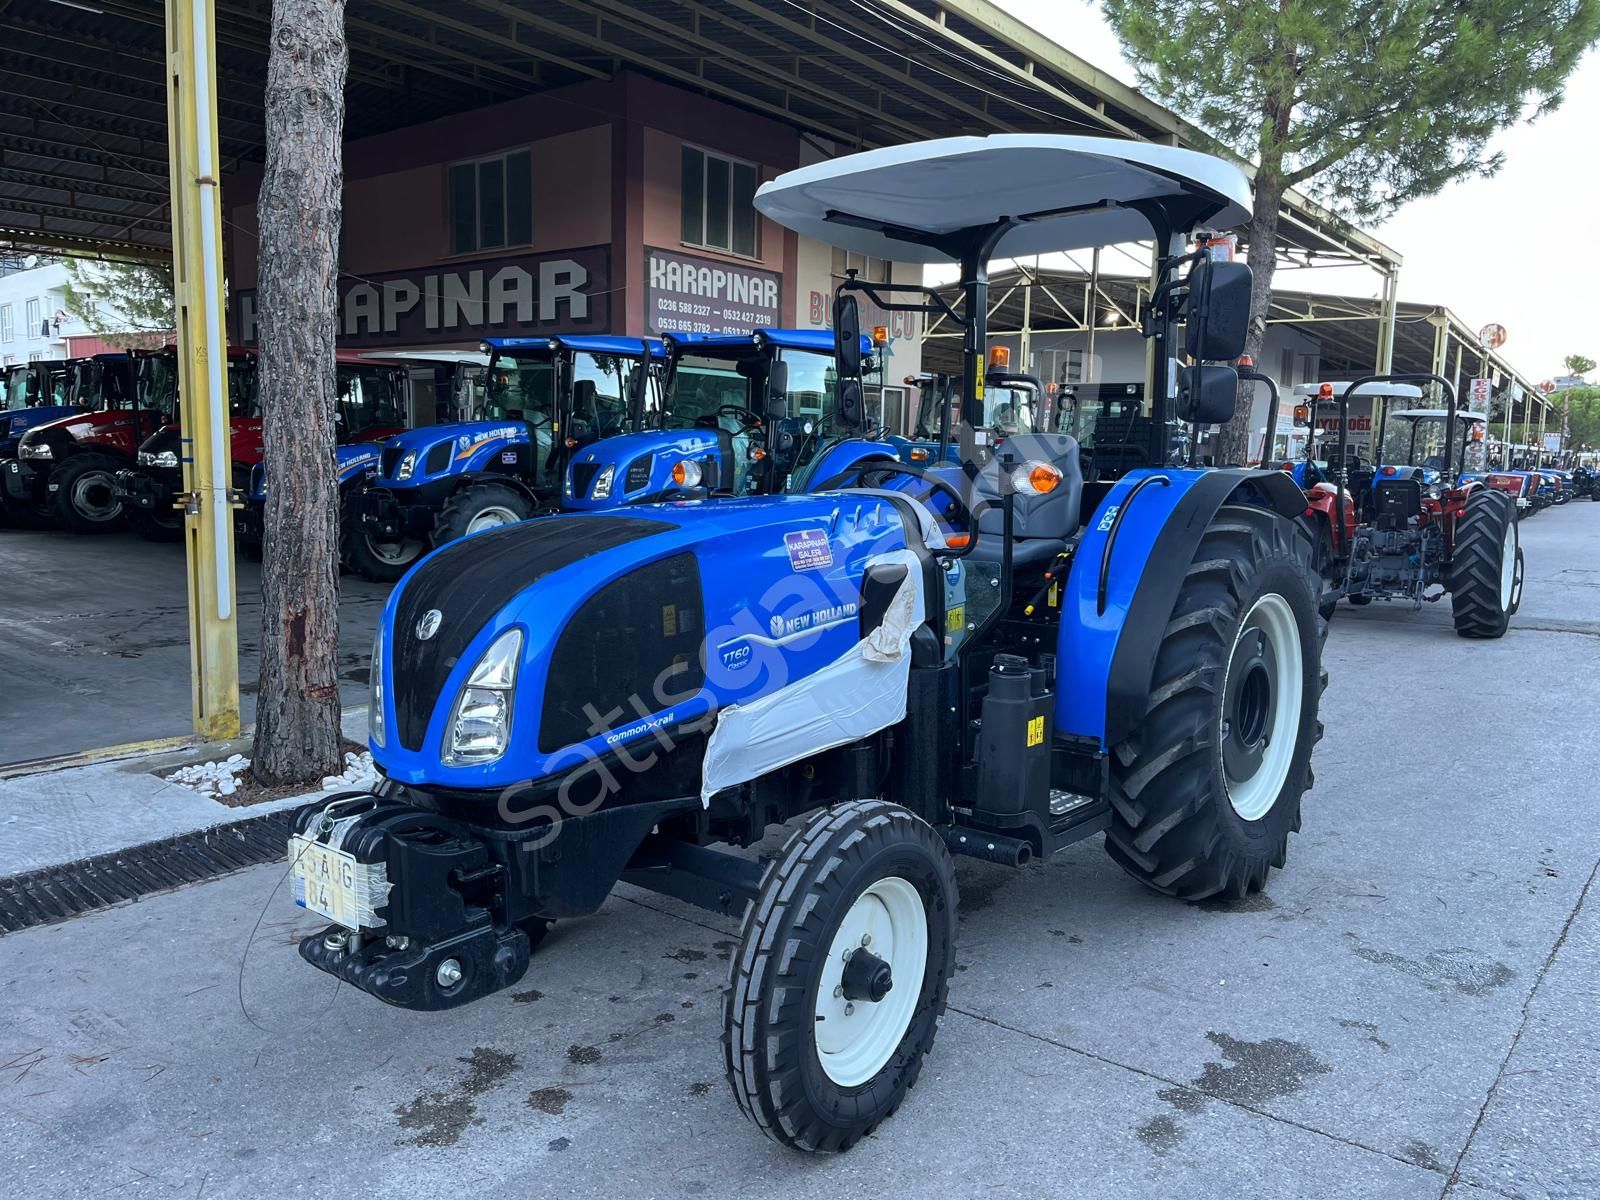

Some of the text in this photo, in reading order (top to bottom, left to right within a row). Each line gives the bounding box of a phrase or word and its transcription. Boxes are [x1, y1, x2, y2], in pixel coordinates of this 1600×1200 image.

[650, 257, 777, 309] KARAPINAR
[658, 298, 677, 310] 0236
[679, 302, 692, 314] 588
[693, 305, 711, 316] 2327
[723, 309, 741, 321] 0532
[741, 312, 755, 323] 427
[755, 314, 771, 326] 2319
[658, 317, 677, 330] 0533
[678, 320, 692, 332] 665
[693, 323, 711, 334] 3792
[789, 539, 827, 550] KARAPINAR
[786, 603, 857, 633] NEW HOLLAND
[723, 646, 750, 664] TT60
[728, 659, 749, 672] Classic
